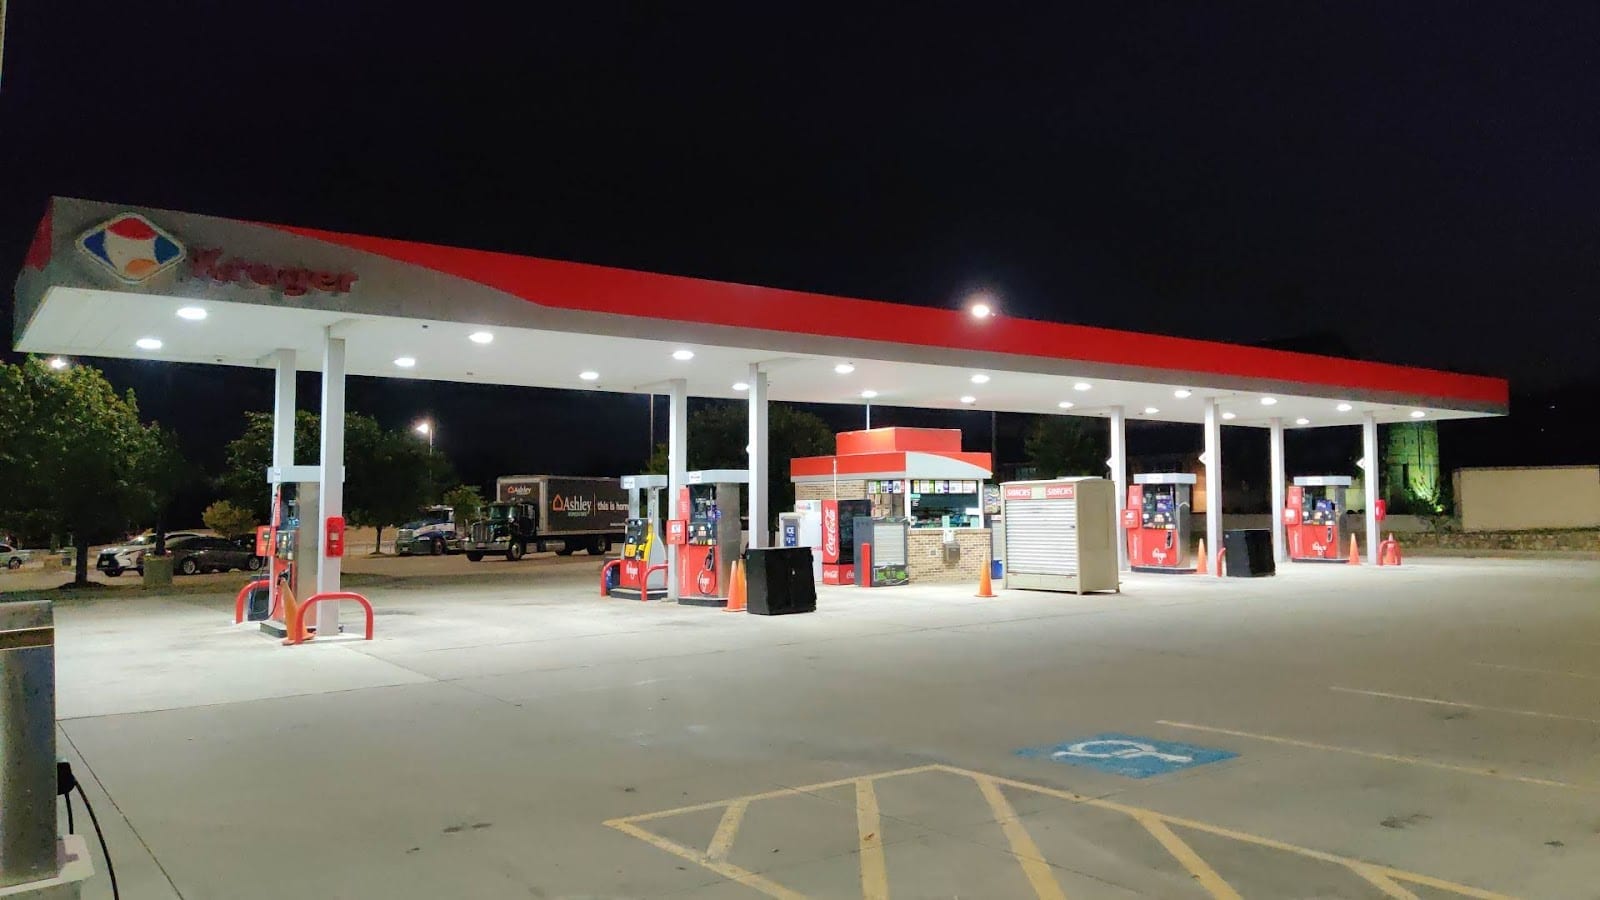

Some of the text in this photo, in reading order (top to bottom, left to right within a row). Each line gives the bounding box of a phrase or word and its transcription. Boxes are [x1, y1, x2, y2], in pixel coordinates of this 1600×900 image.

[190, 246, 358, 296] Kroger
[514, 485, 532, 495] Ashley
[564, 495, 592, 514] Ashley
[597, 501, 609, 510] this
[616, 502, 629, 510] hom
[825, 507, 836, 556] Coca-Cola
